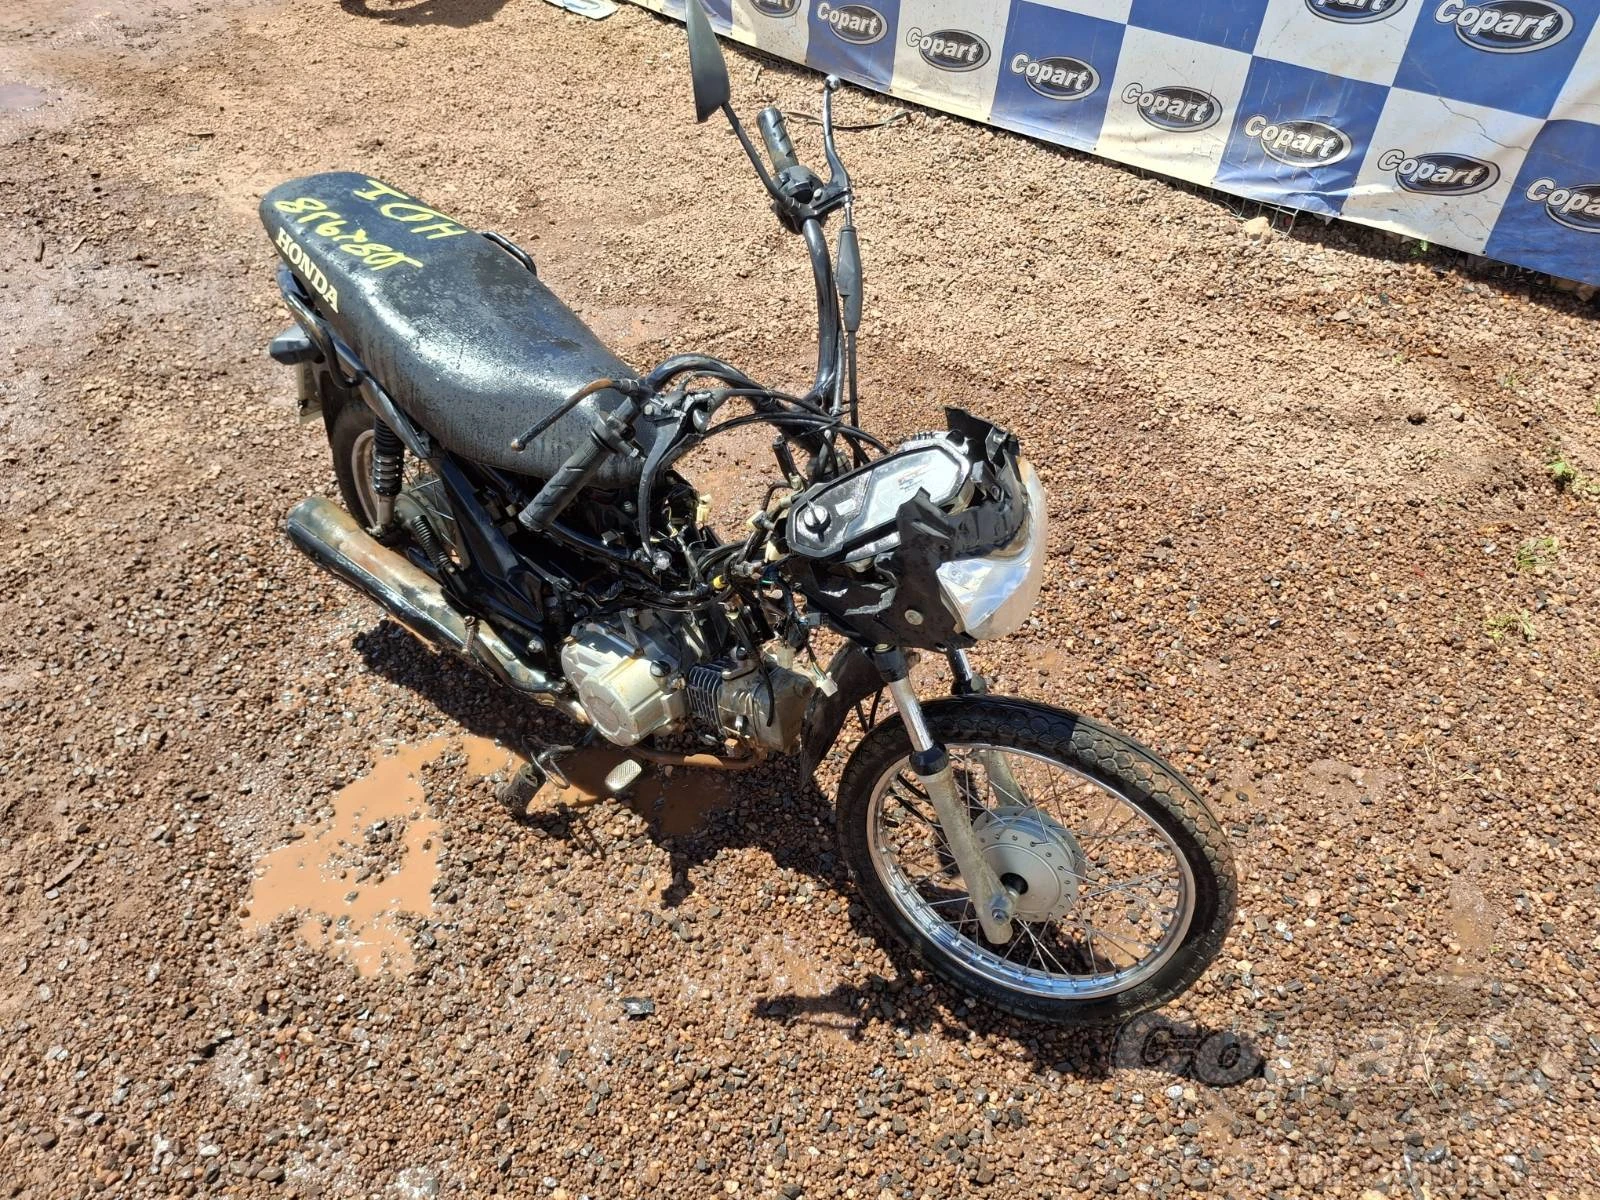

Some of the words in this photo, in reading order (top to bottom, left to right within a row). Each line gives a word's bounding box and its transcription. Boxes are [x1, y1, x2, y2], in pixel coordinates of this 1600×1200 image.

[817, 2, 878, 35] Copart
[1434, 0, 1558, 41] Copart
[906, 27, 981, 62] Copart
[1011, 53, 1089, 91] Copart
[1121, 82, 1209, 122] Copart
[1244, 114, 1339, 158] Copart
[1378, 149, 1485, 185] Copart
[275, 227, 339, 313] HONDA
